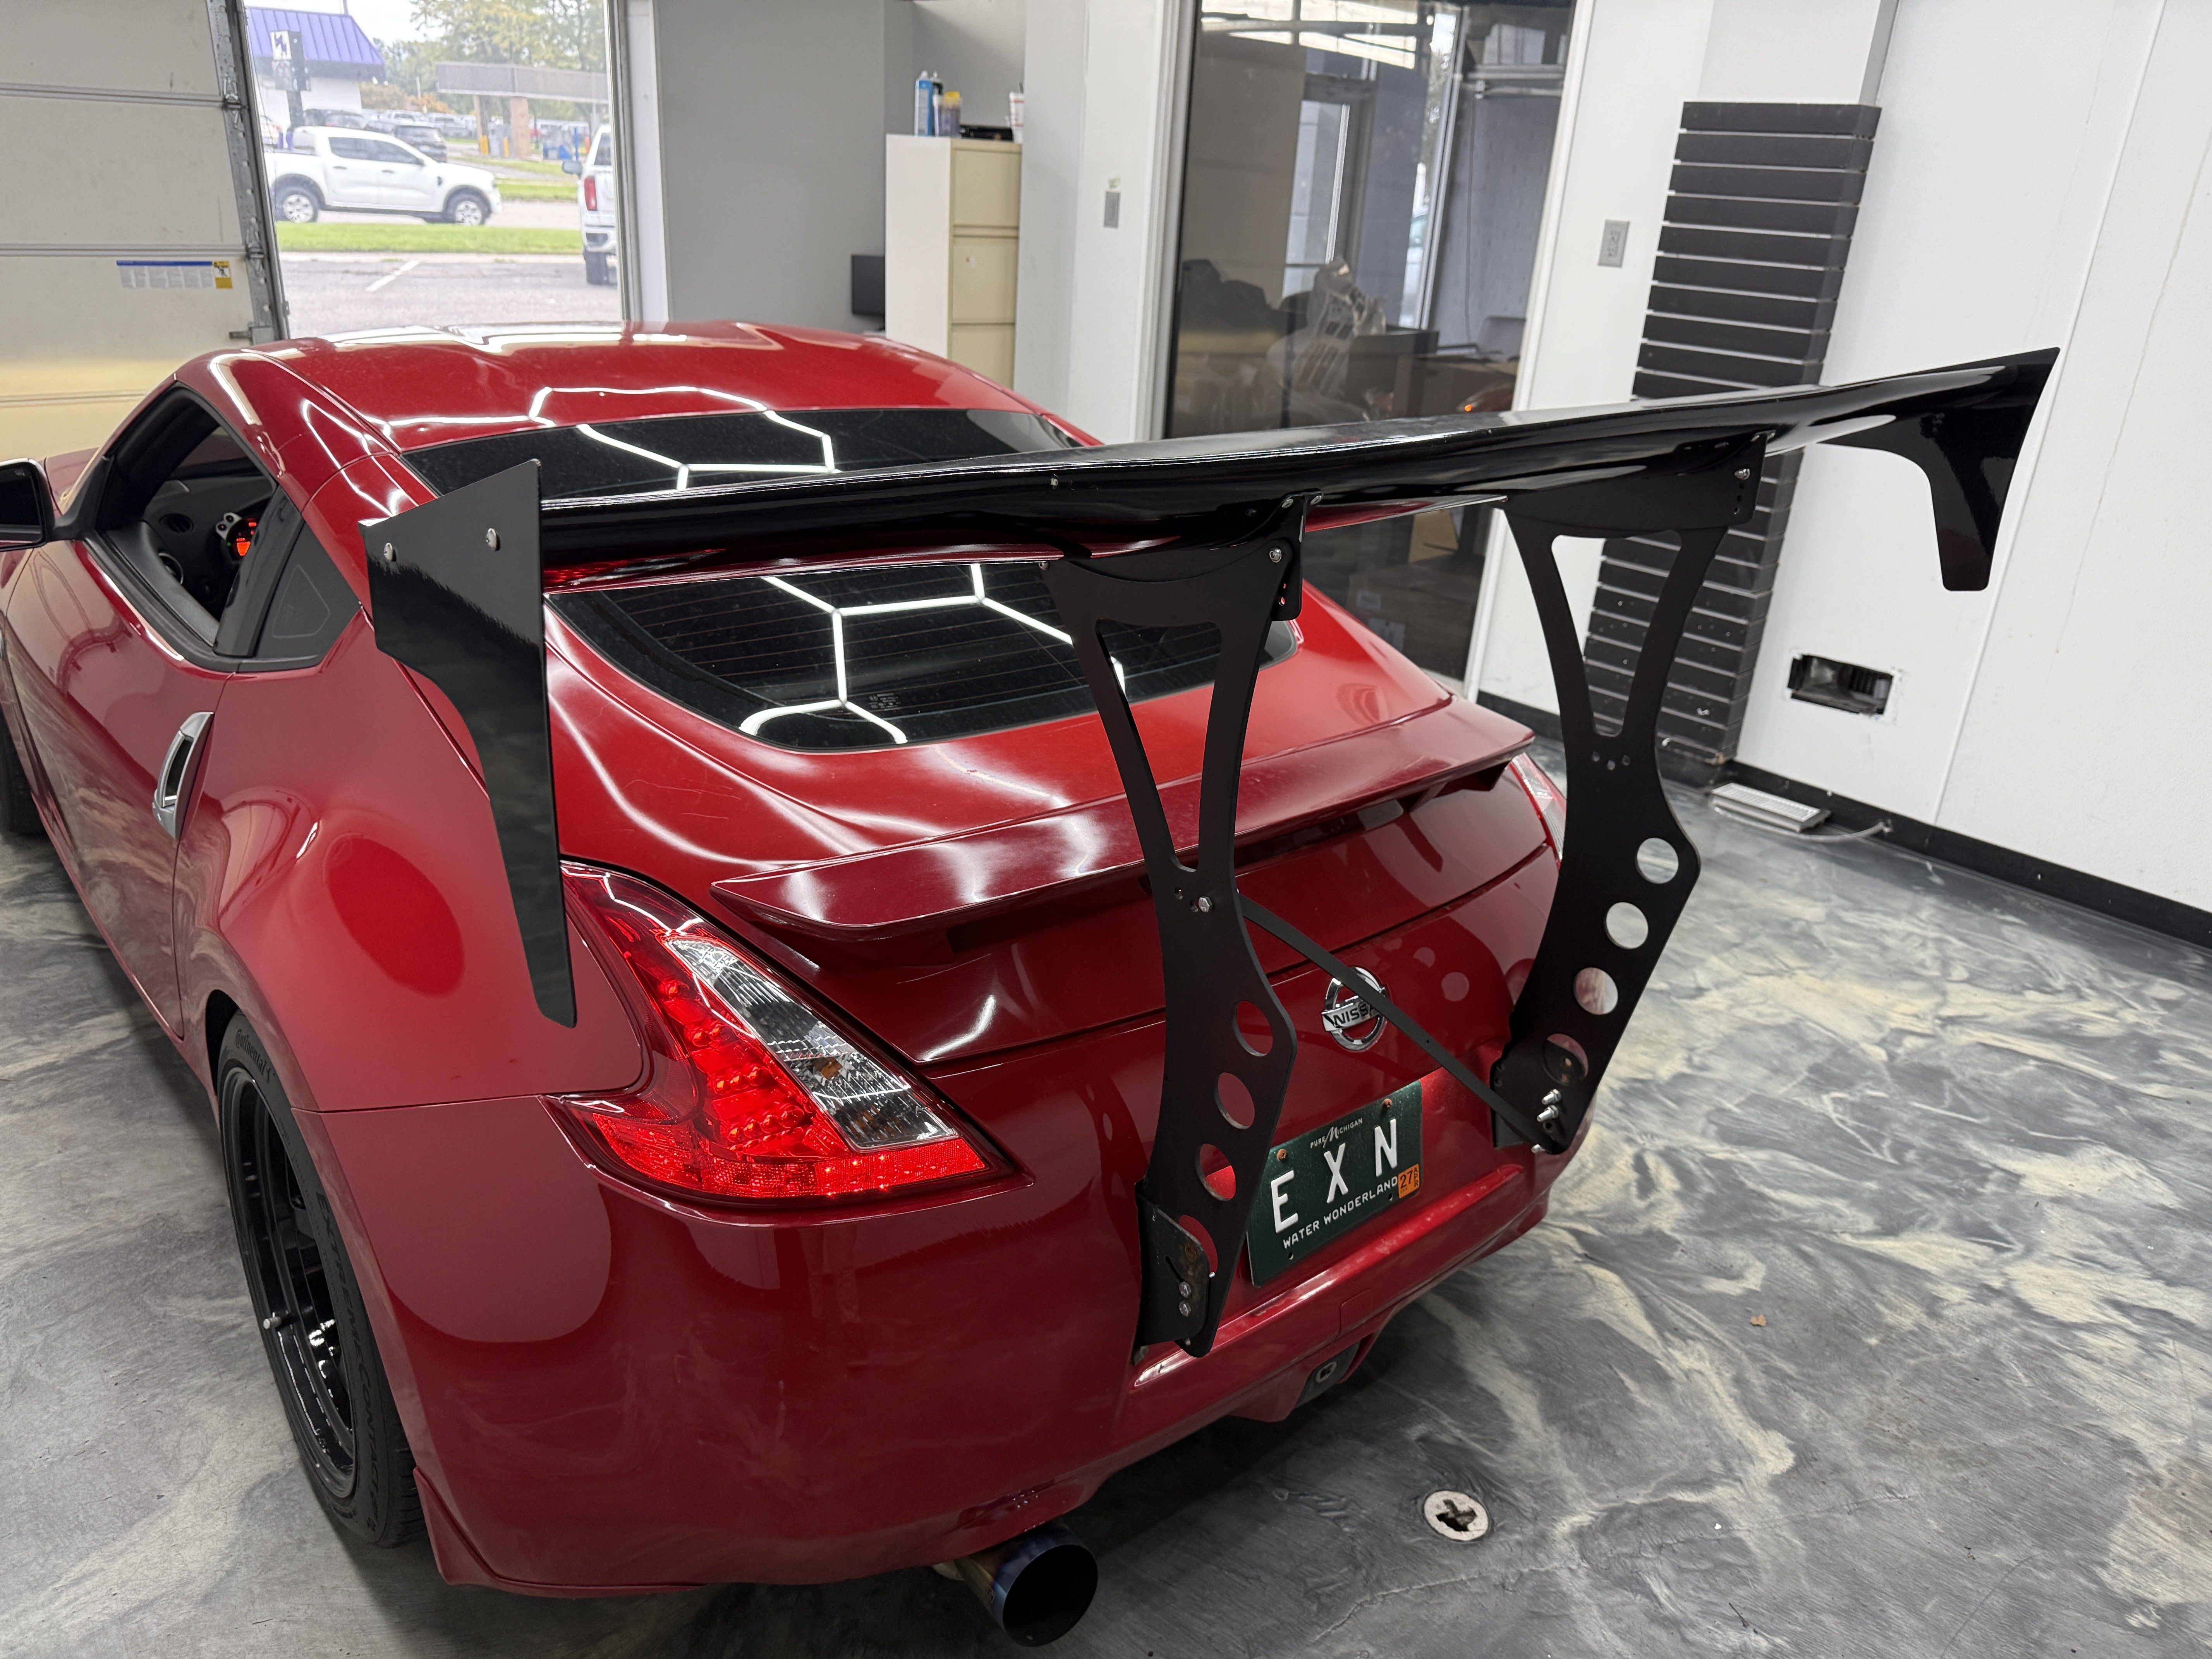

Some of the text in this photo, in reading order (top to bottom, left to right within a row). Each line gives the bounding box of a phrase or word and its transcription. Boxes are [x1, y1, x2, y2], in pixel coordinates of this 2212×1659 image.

[1333, 1003, 1373, 1025] NISS
[235, 1029, 267, 1076] Continental
[1310, 1118, 1363, 1149] PURE MICHIGAN
[1400, 1170, 1413, 1189] 27
[1283, 1176, 1398, 1249] WATER WONDERLAND
